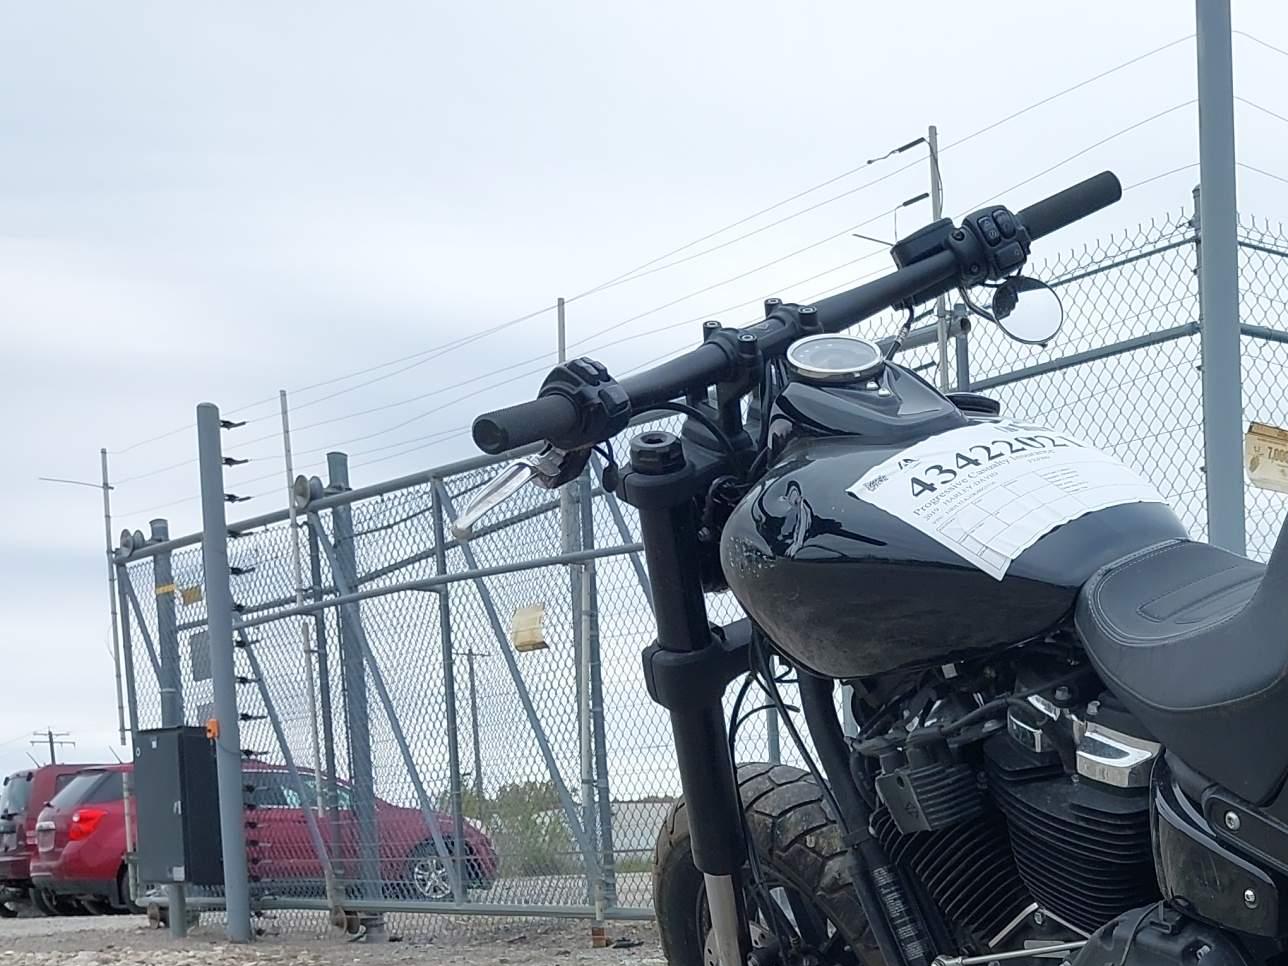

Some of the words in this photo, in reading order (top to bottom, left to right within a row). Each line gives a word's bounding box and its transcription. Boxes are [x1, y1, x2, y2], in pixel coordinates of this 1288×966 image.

[909, 434, 1087, 498] 43422021
[913, 477, 969, 517] Progressive
[967, 459, 1010, 480] Casualty
